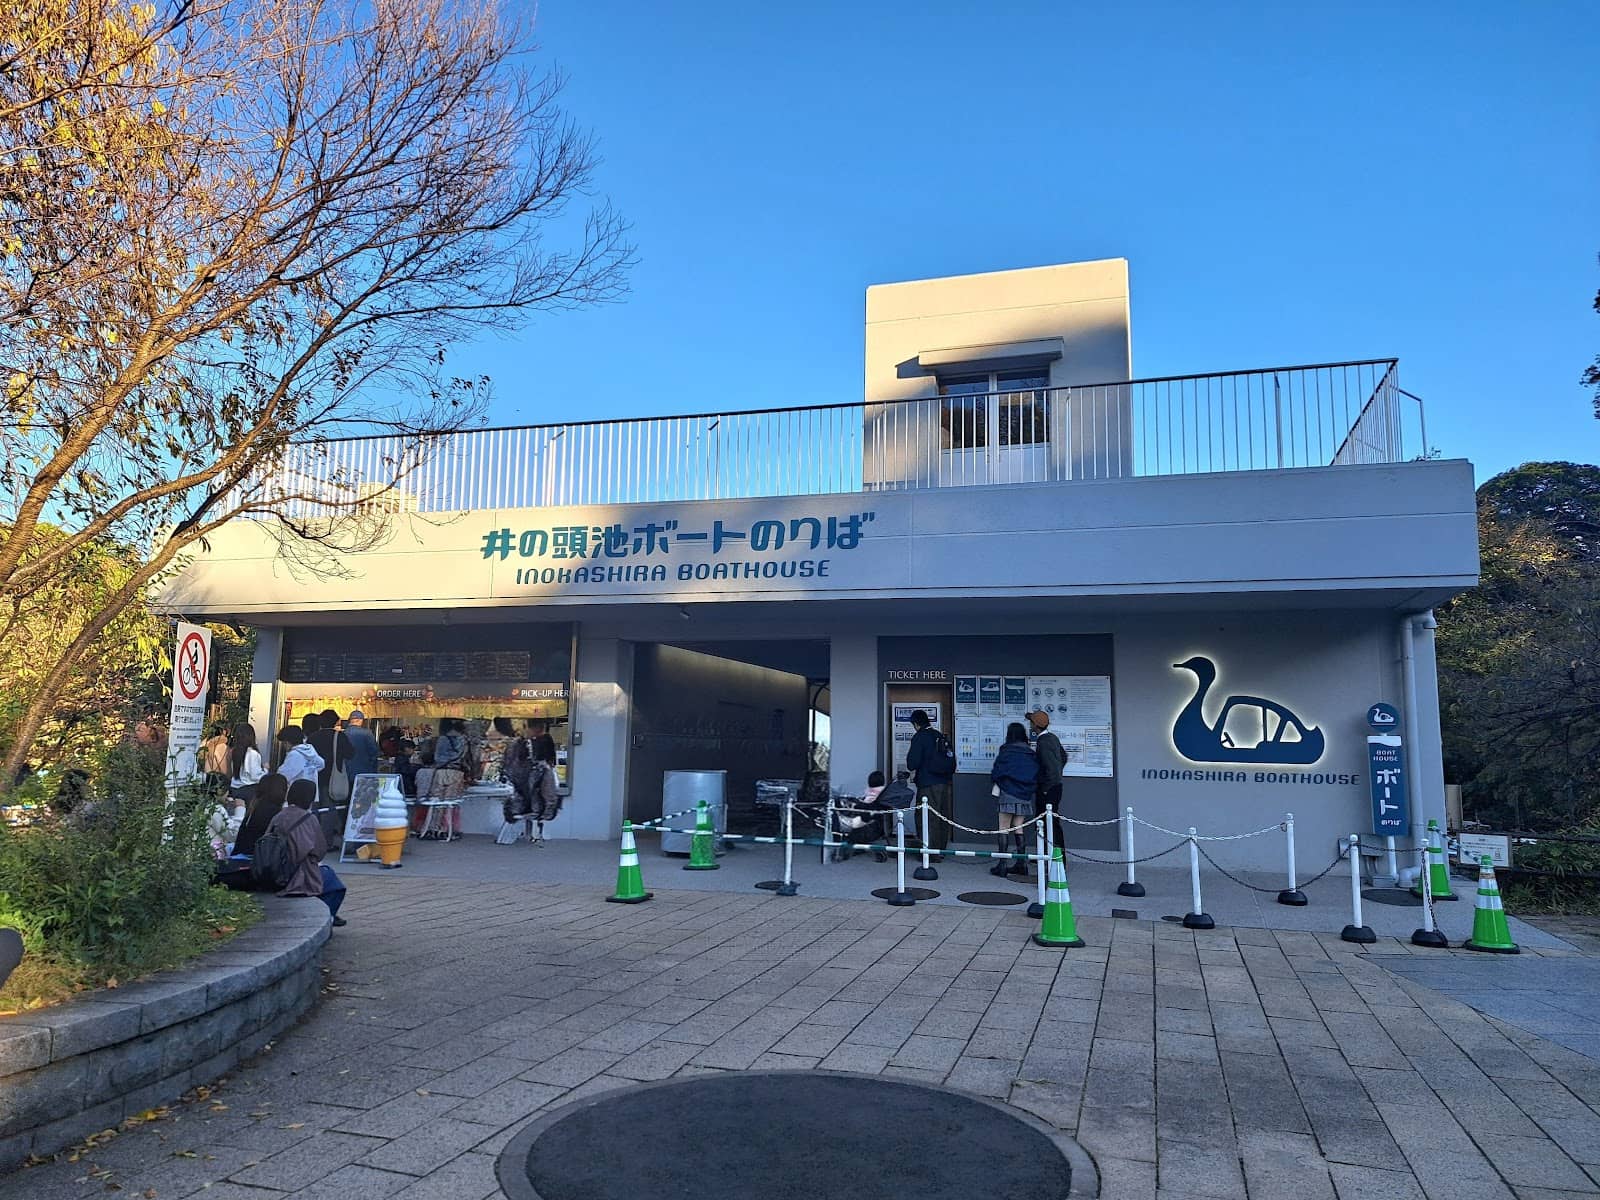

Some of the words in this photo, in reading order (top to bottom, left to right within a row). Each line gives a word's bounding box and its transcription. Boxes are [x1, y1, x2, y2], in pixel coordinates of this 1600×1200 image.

[480, 511, 876, 561] 井の頭池ボートのりば
[516, 564, 666, 585] INOKASHIRA
[678, 560, 831, 581] BOATHOUSE
[888, 670, 920, 679] TICKET
[923, 670, 947, 679] HERE
[376, 689, 401, 698] ORDER
[403, 689, 422, 698] HERE
[520, 689, 553, 698] PICK-UP
[1141, 768, 1247, 783] INOKASHIRA
[1254, 772, 1361, 786] BOATHOUSE
[1377, 768, 1401, 816] ボート
